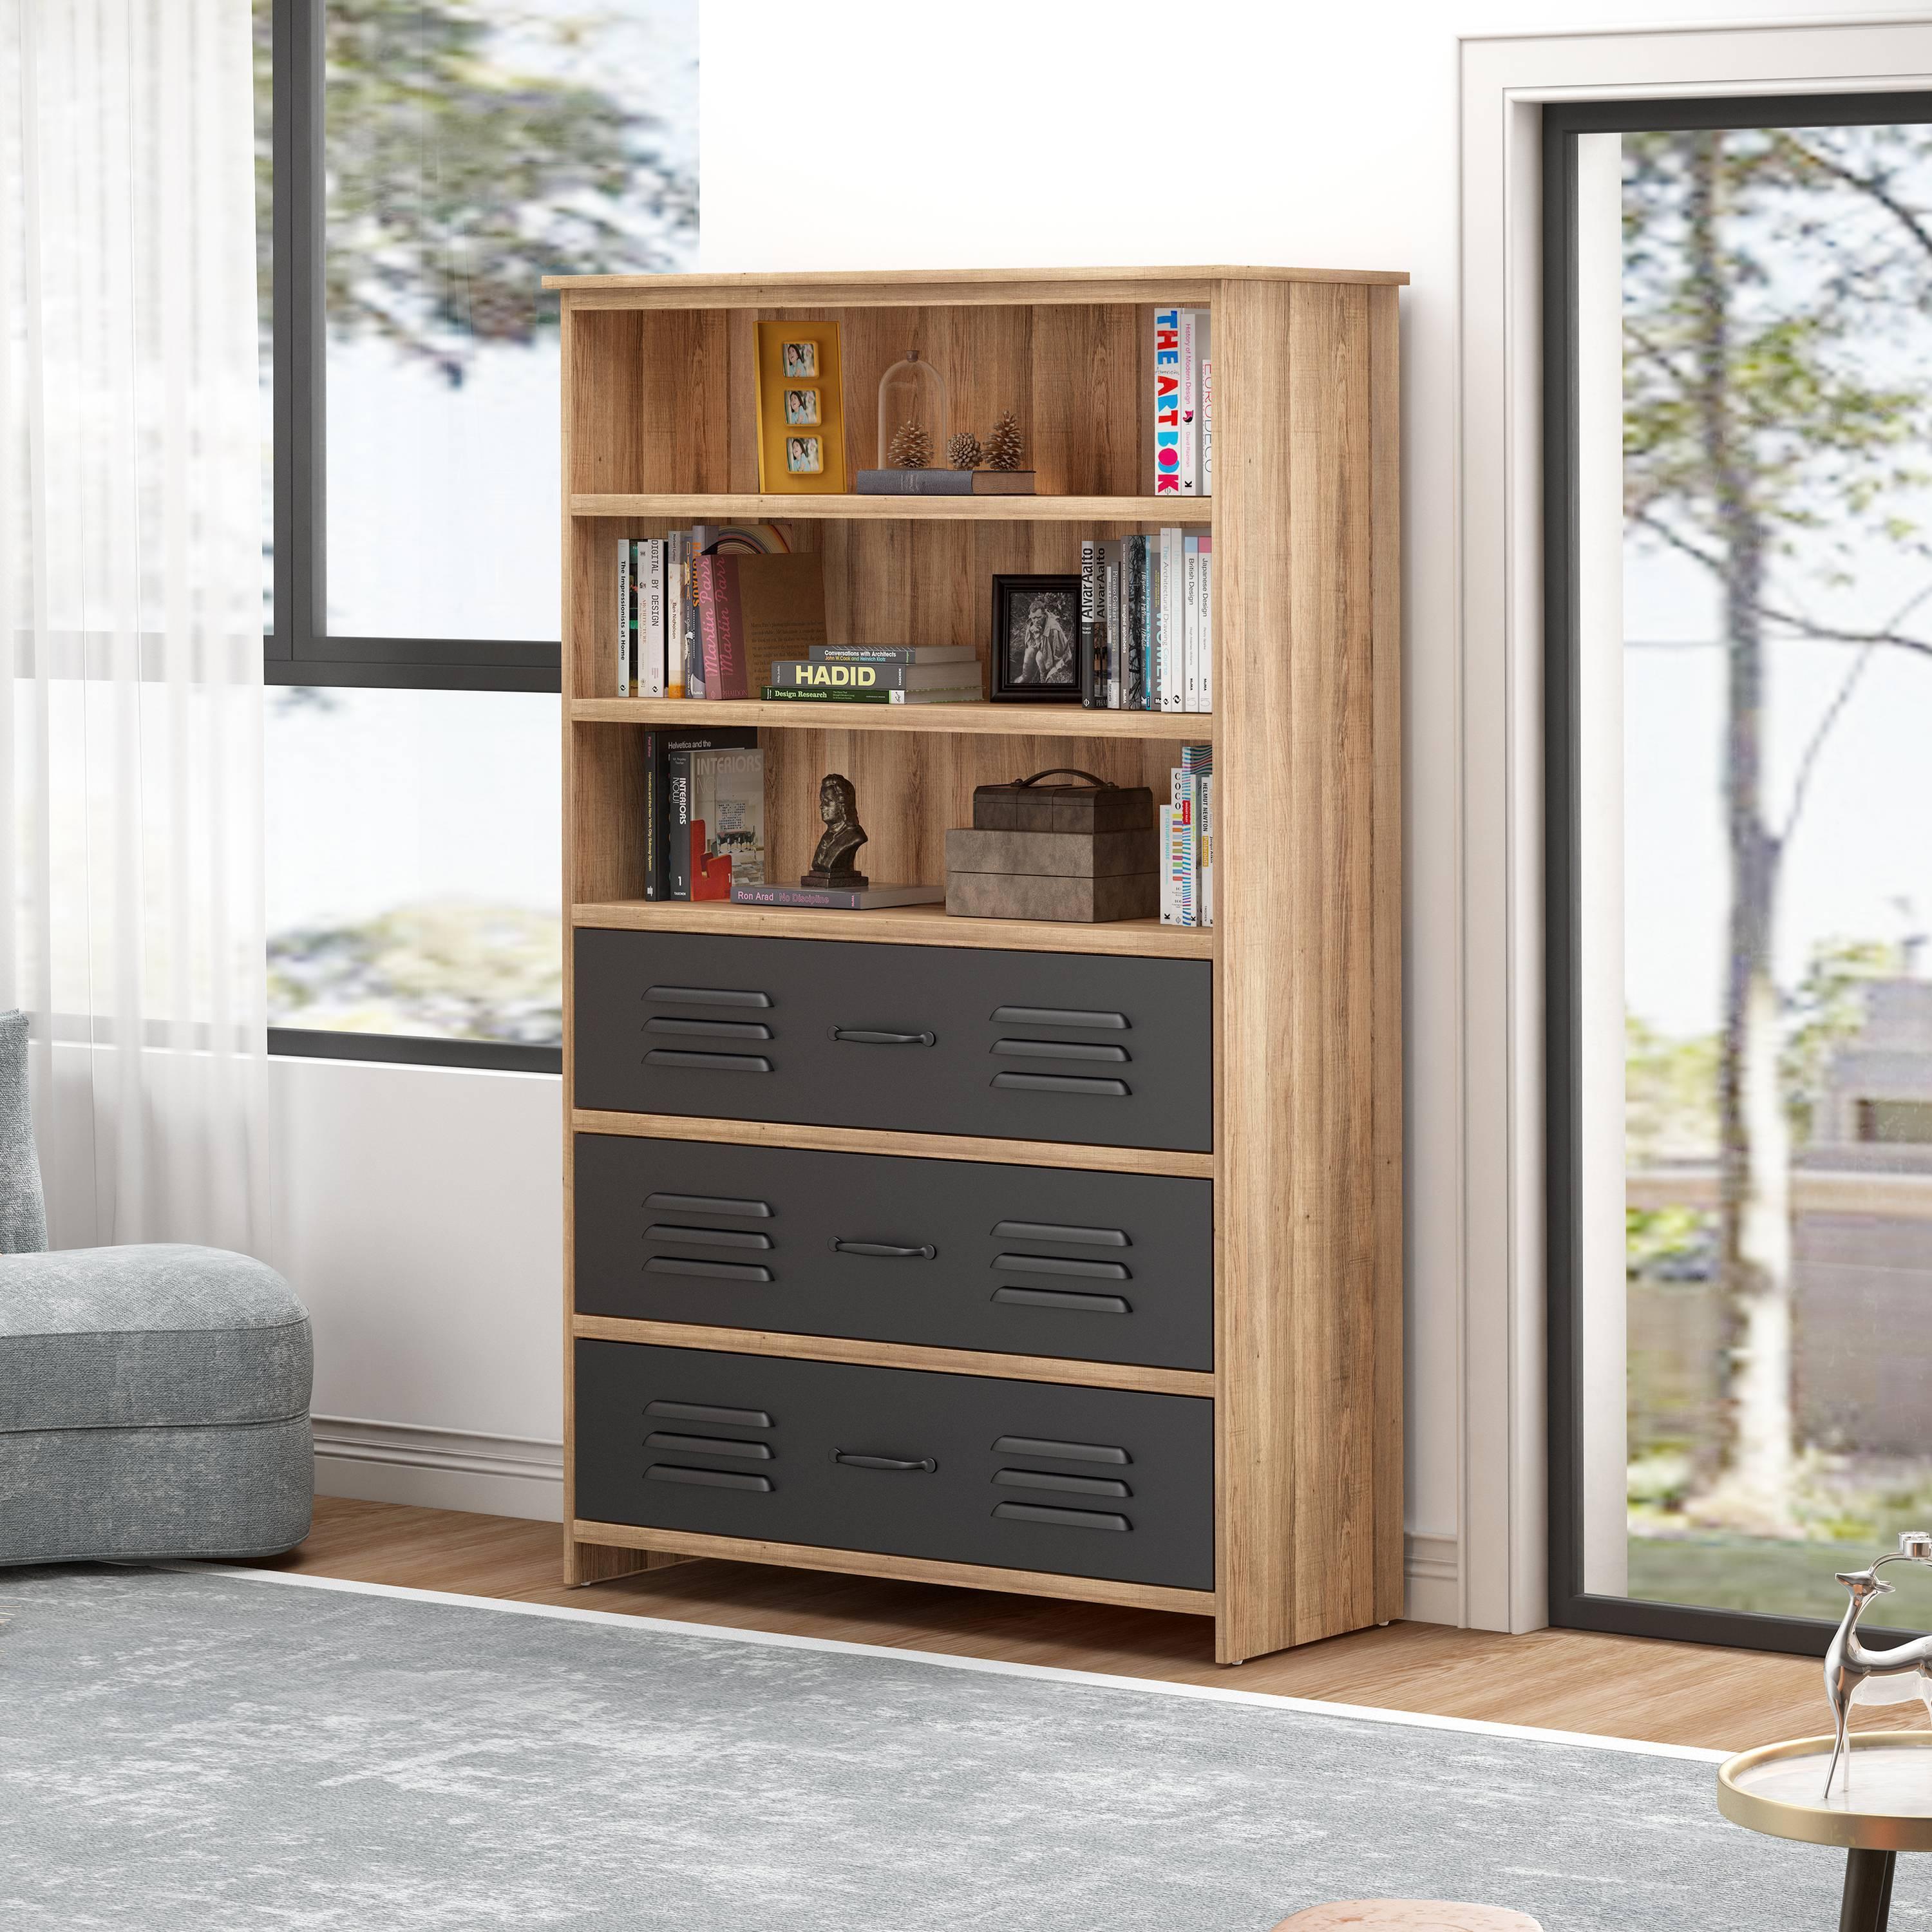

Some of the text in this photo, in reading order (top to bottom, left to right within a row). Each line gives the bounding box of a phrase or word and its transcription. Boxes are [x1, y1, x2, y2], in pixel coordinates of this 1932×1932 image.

[1157, 310, 1180, 493] THE ART BOOK
[651, 580, 659, 589] BY
[699, 558, 718, 676] Martin Parr
[715, 557, 734, 676] Martin Parr
[620, 630, 626, 639] at
[795, 665, 876, 686] HADID
[774, 690, 797, 699] Design
[697, 755, 762, 775] INTERIORS
[677, 876, 681, 886] 1
[728, 873, 731, 883] 1
[738, 891, 773, 901] Ron Arad
[779, 893, 829, 905] No Discipline
